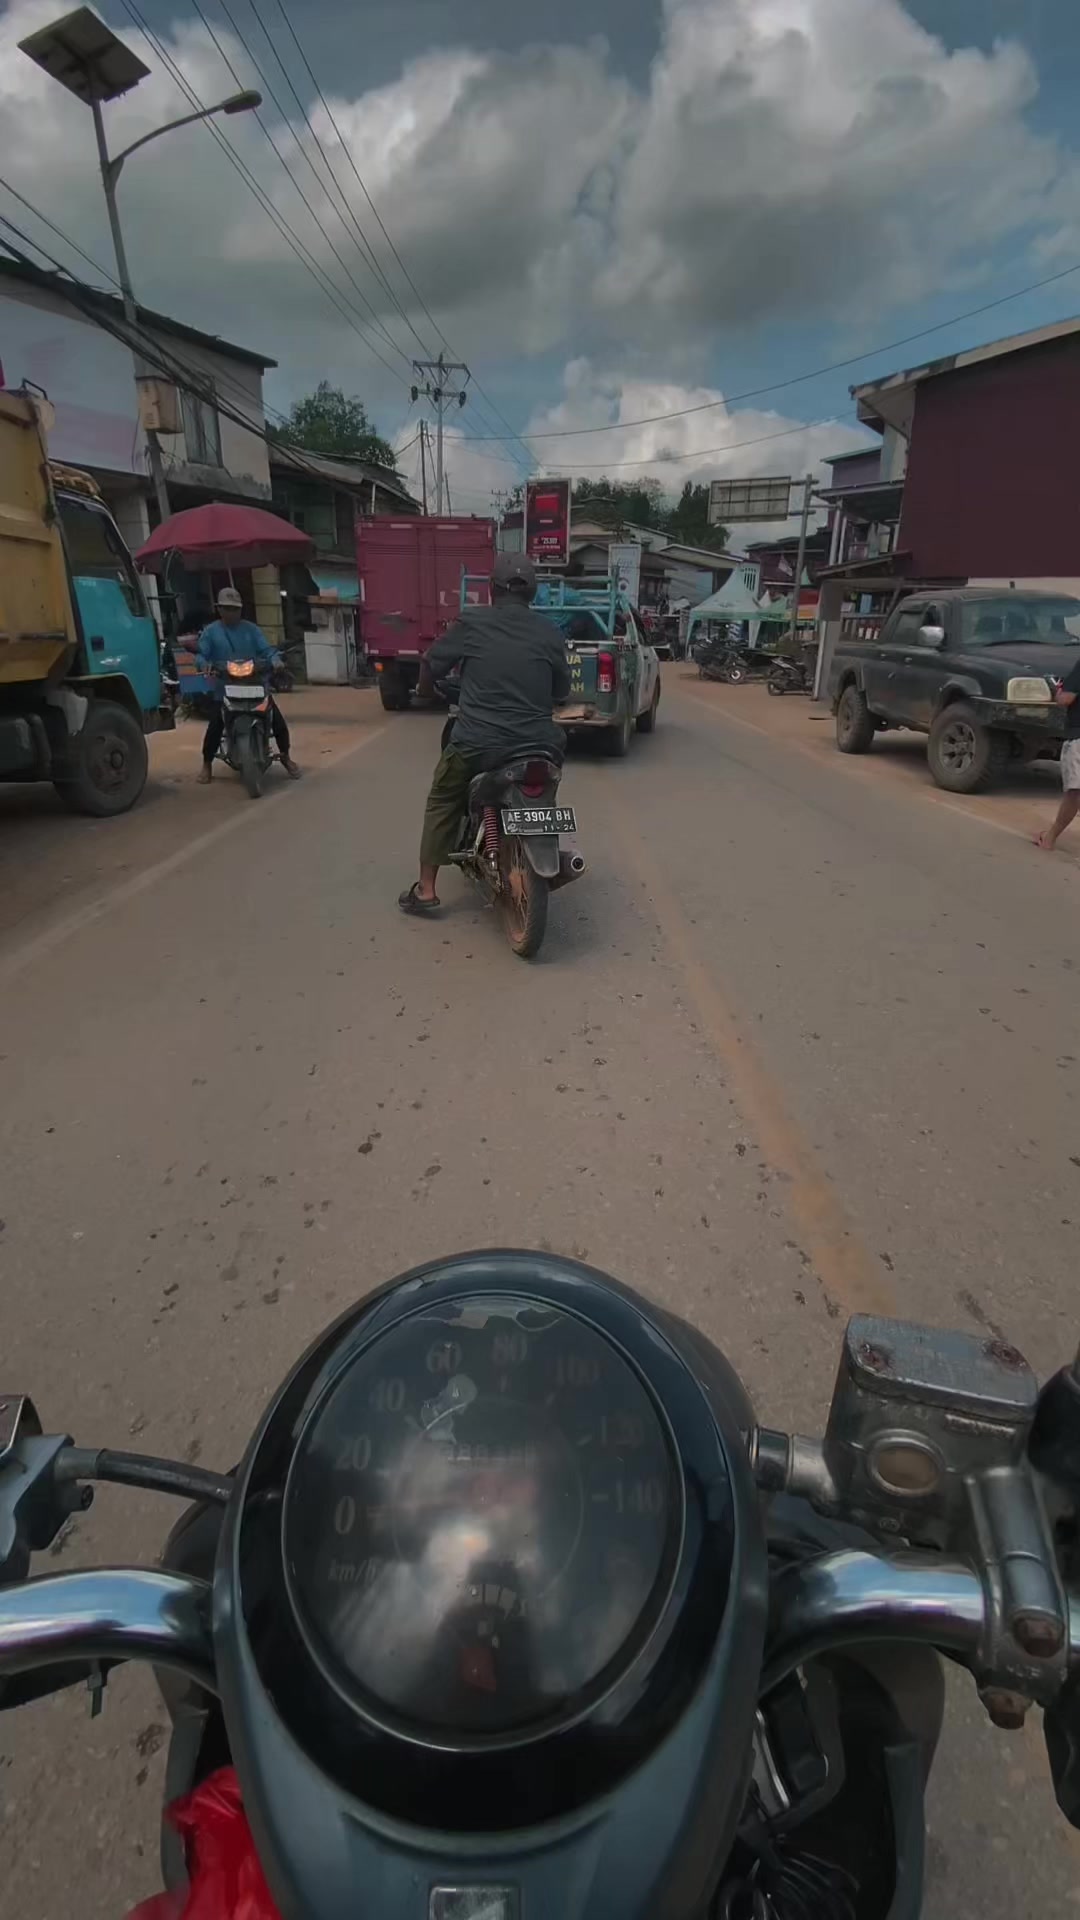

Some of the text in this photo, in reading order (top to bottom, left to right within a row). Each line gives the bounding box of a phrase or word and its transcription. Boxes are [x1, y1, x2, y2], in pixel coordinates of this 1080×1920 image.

[507, 809, 571, 822] AE 3904 BH
[426, 1339, 462, 1371] 60
[336, 1432, 370, 1471] 20
[335, 1496, 355, 1536] 0
